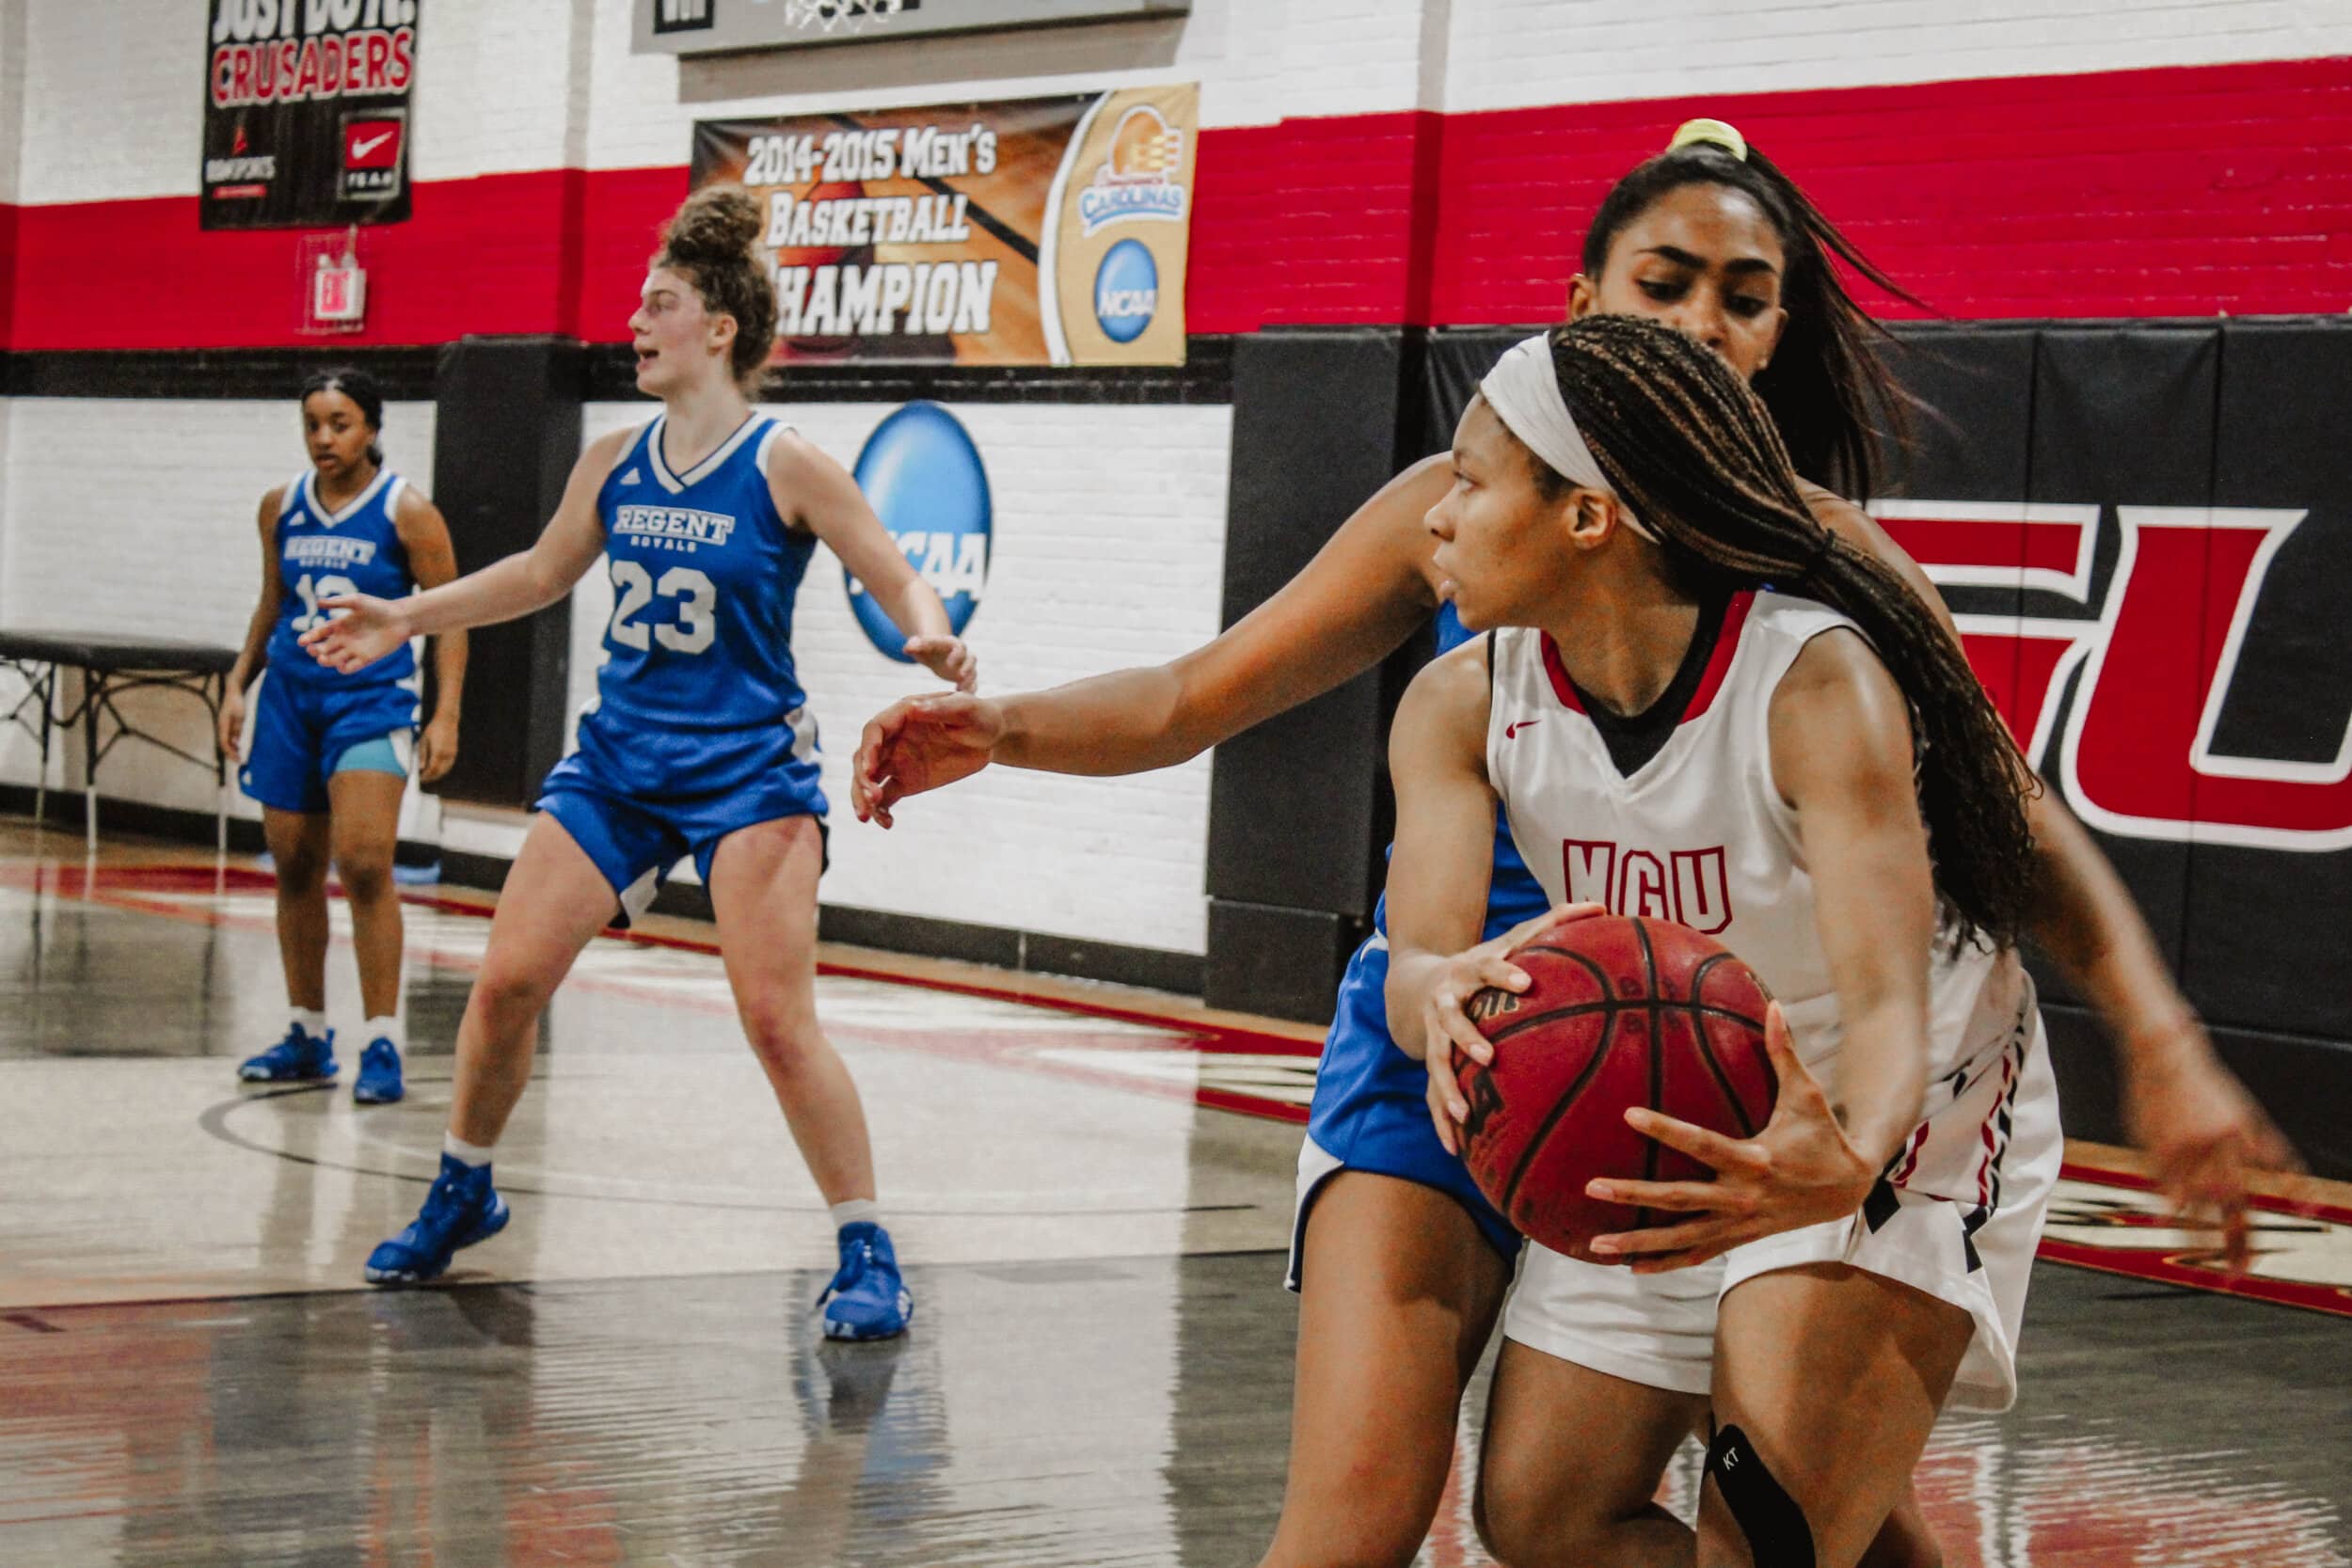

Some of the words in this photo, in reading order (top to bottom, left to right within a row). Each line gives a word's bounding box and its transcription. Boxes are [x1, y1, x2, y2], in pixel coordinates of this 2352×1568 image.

[212, 27, 414, 108] CRUSADERS
[743, 128, 899, 185] 2014-2015
[767, 192, 970, 249] BASKETBALL
[766, 258, 998, 336] HAMPION
[1098, 289, 1156, 318] NCAA
[613, 504, 736, 546] REGENT
[849, 531, 987, 601] CAA
[611, 560, 717, 655] 23
[1562, 838, 1733, 935] NGU
[1723, 1447, 1740, 1471] KT
